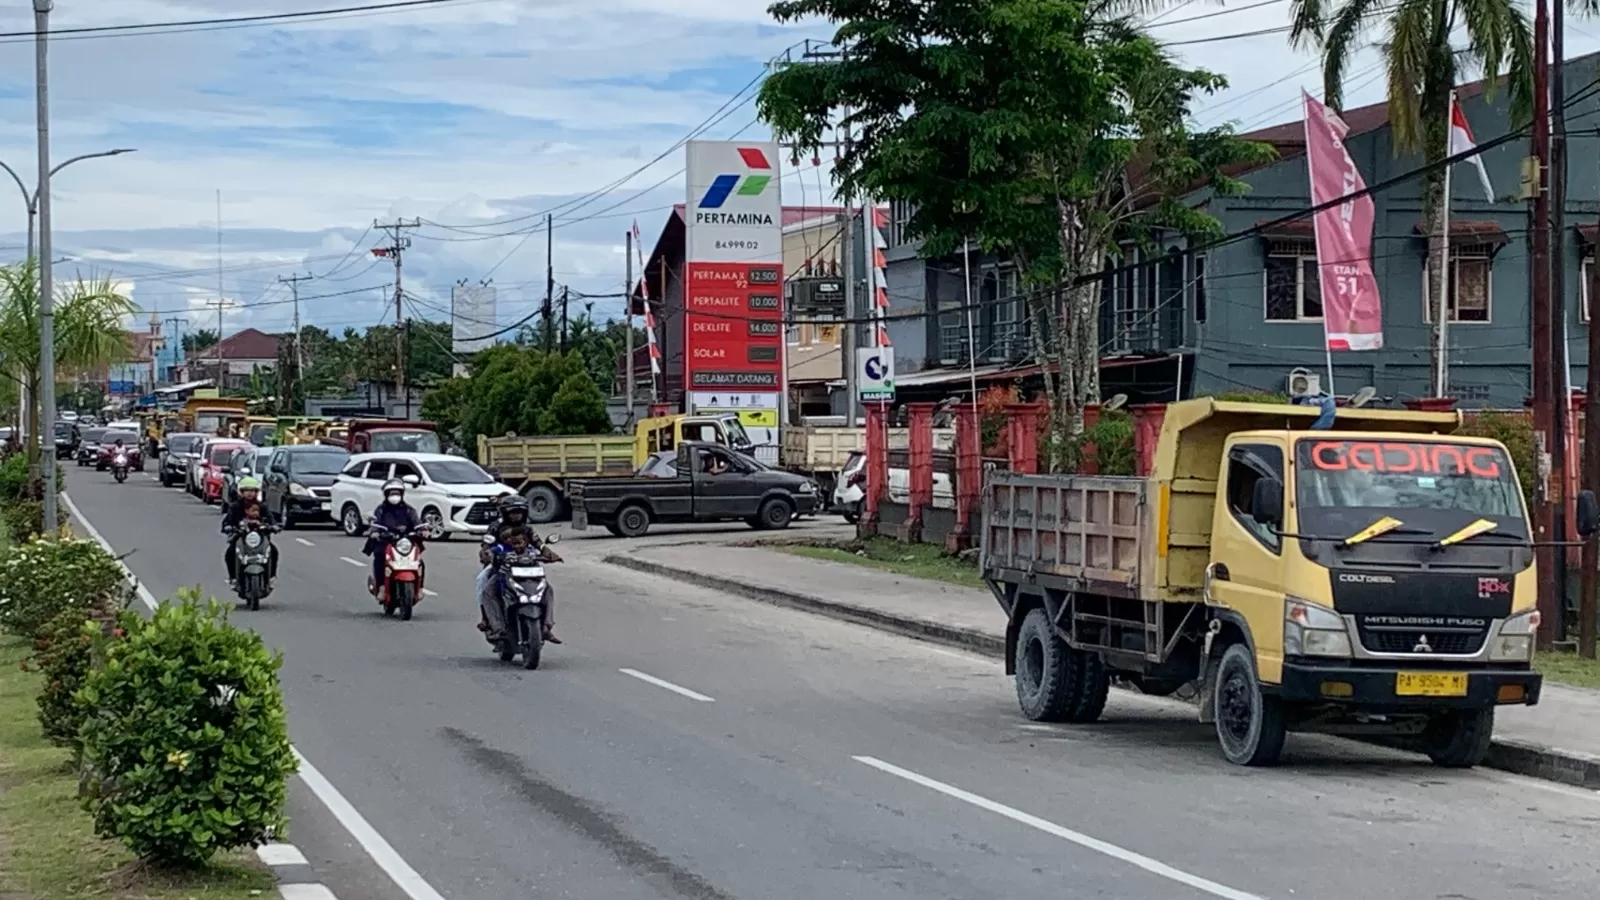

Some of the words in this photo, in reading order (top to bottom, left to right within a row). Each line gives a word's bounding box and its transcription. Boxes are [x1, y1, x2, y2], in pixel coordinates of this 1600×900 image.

[696, 213, 773, 224] PERTAMINA
[715, 240, 759, 249] 84.999.02
[693, 271, 745, 280] PERTAMAX
[735, 280, 748, 289] 92
[1336, 276, 1357, 296] 51
[693, 296, 740, 306] PERTALITE
[751, 297, 778, 307] 10.000
[693, 322, 731, 332] DEXLITE
[693, 348, 726, 358] SOLAR
[694, 374, 735, 383] SELAMAT
[737, 374, 772, 384] DATANG
[1339, 574, 1366, 583] COLT
[1364, 616, 1443, 625] MITSUBISHI
[1447, 618, 1485, 626] FUSO
